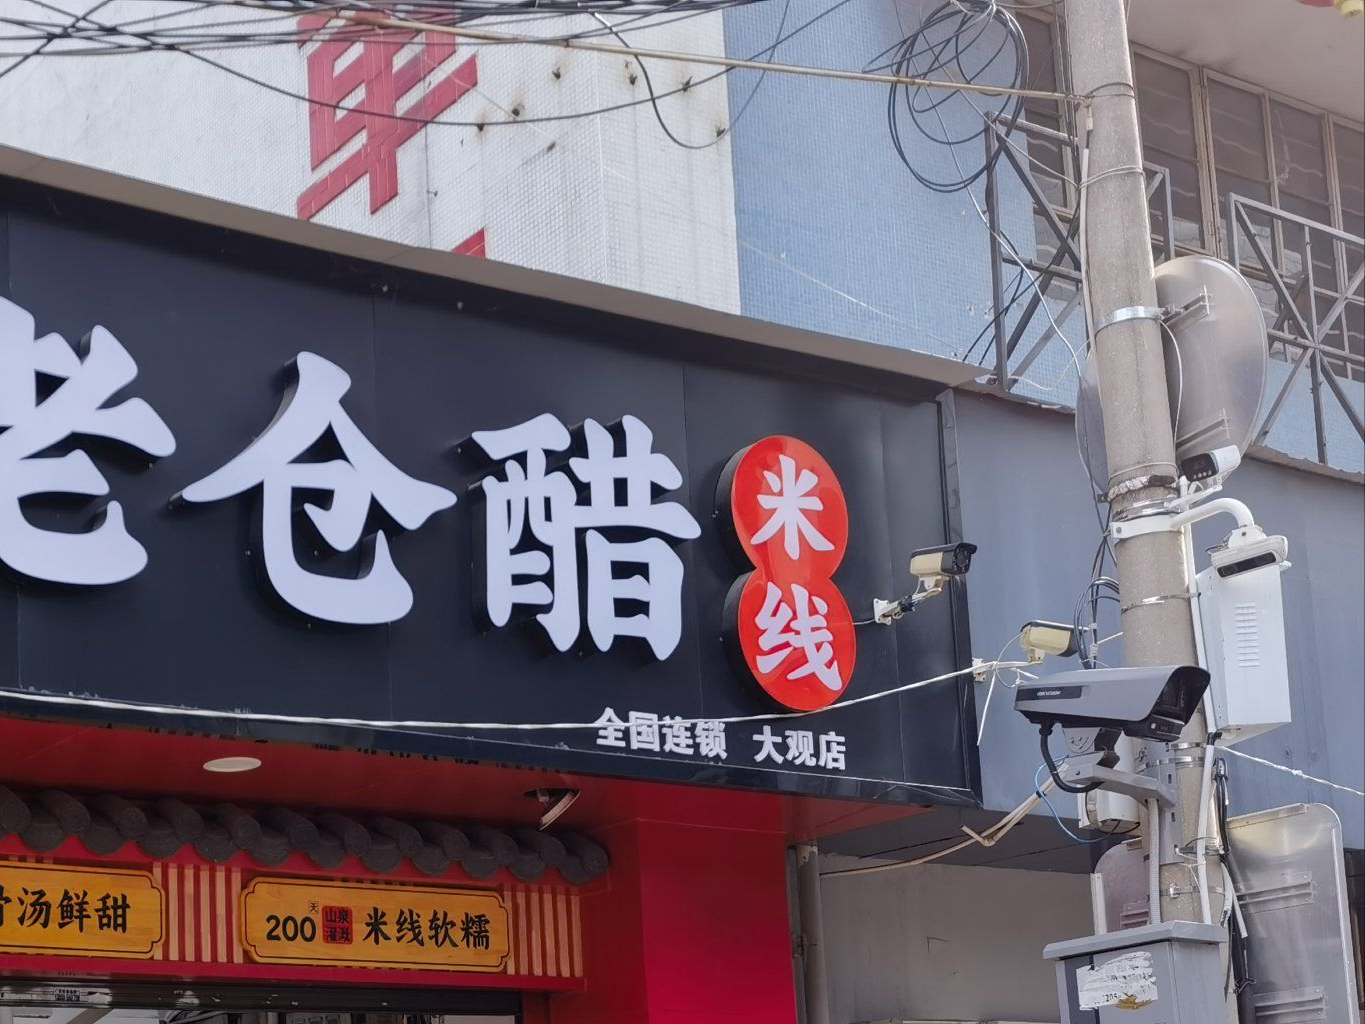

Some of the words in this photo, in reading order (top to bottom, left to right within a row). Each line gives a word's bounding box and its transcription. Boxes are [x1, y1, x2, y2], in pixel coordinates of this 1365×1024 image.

[750, 454, 844, 691] 米线
[595, 706, 728, 760] 全国连锁
[752, 724, 846, 770] 大观店
[265, 914, 317, 943] 200
[362, 906, 490, 950] 米线软糯
[325, 908, 349, 923] 山泉
